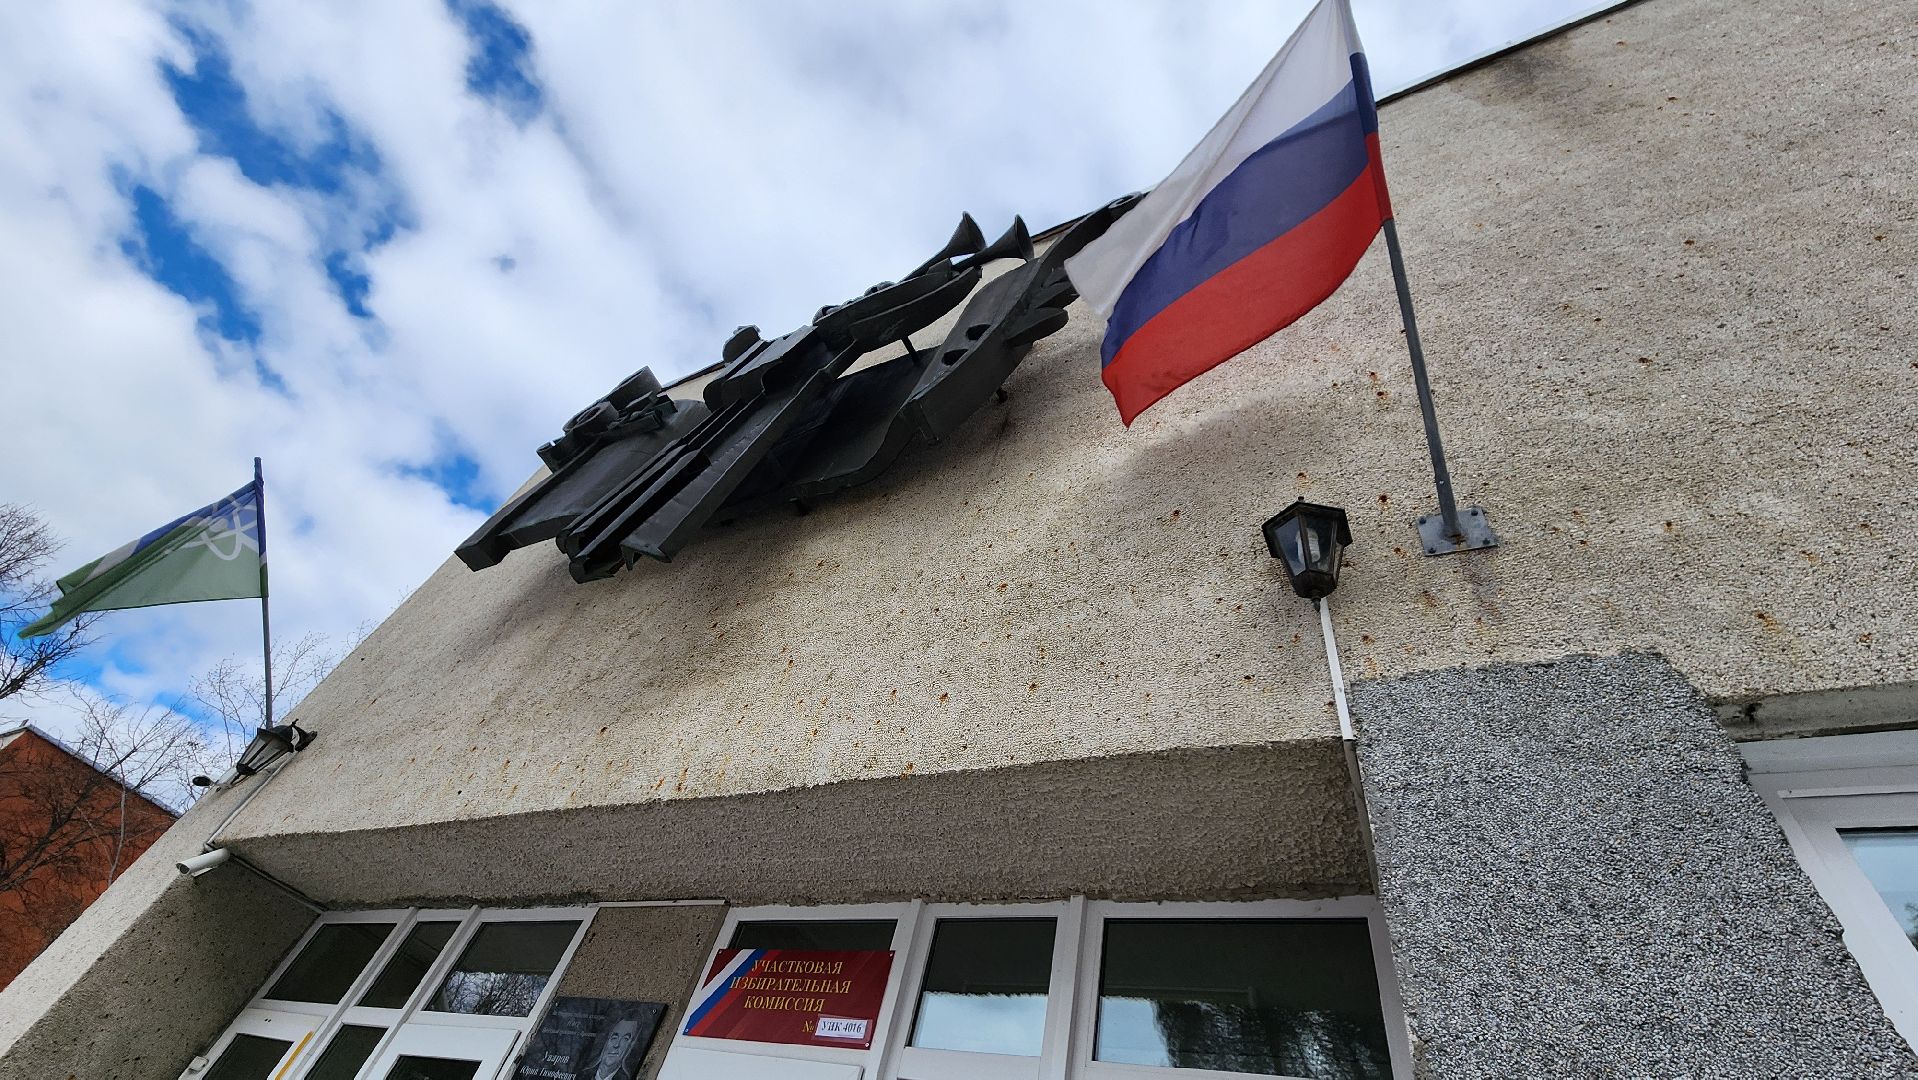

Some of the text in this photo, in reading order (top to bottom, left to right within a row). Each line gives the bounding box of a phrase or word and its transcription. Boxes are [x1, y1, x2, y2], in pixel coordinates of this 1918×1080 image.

[751, 960, 843, 975] УЧАСТКОВАЯ
[729, 976, 852, 994] ИЗБИРАТЕЛЬНАЯ
[743, 995, 826, 1012] КОМИССИЯ
[802, 1020, 863, 1034] № УИК 4016
[542, 1051, 570, 1066] Уваров
[520, 1065, 539, 1077] Юрий
